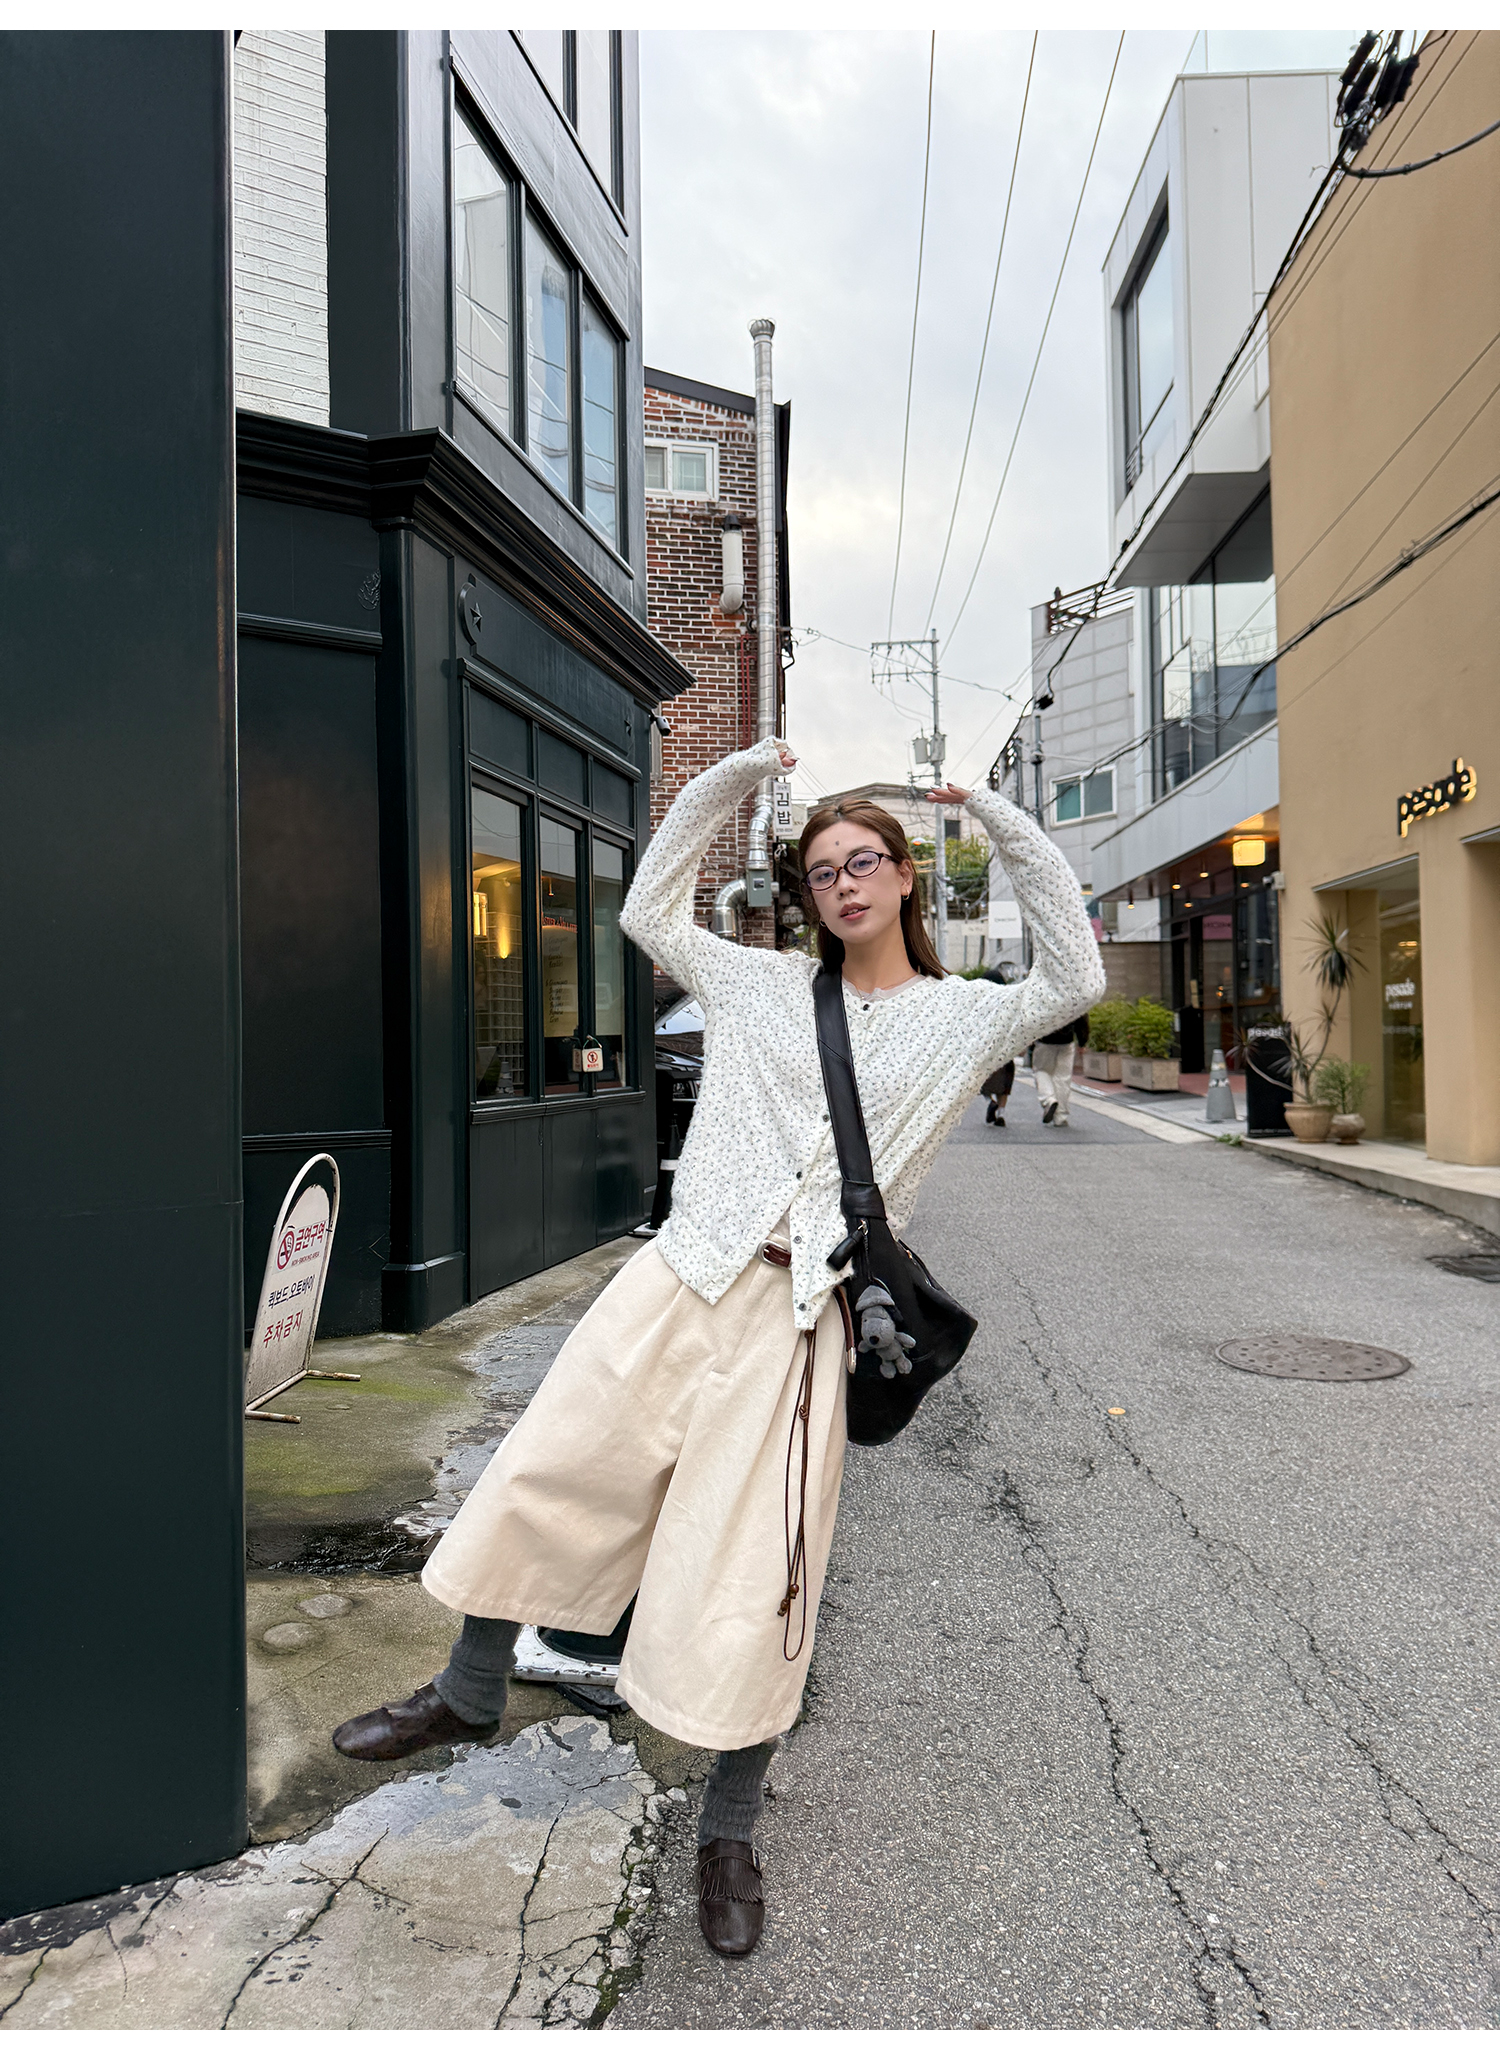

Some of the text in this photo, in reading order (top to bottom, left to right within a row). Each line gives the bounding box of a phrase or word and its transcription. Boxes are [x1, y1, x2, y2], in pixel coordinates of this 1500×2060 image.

[776, 792, 792, 825] 김밥
[1398, 757, 1477, 838] pesade
[294, 1220, 326, 1253] 금연구역
[289, 1274, 315, 1300] 오토바이
[263, 1309, 304, 1348] 주차금지
